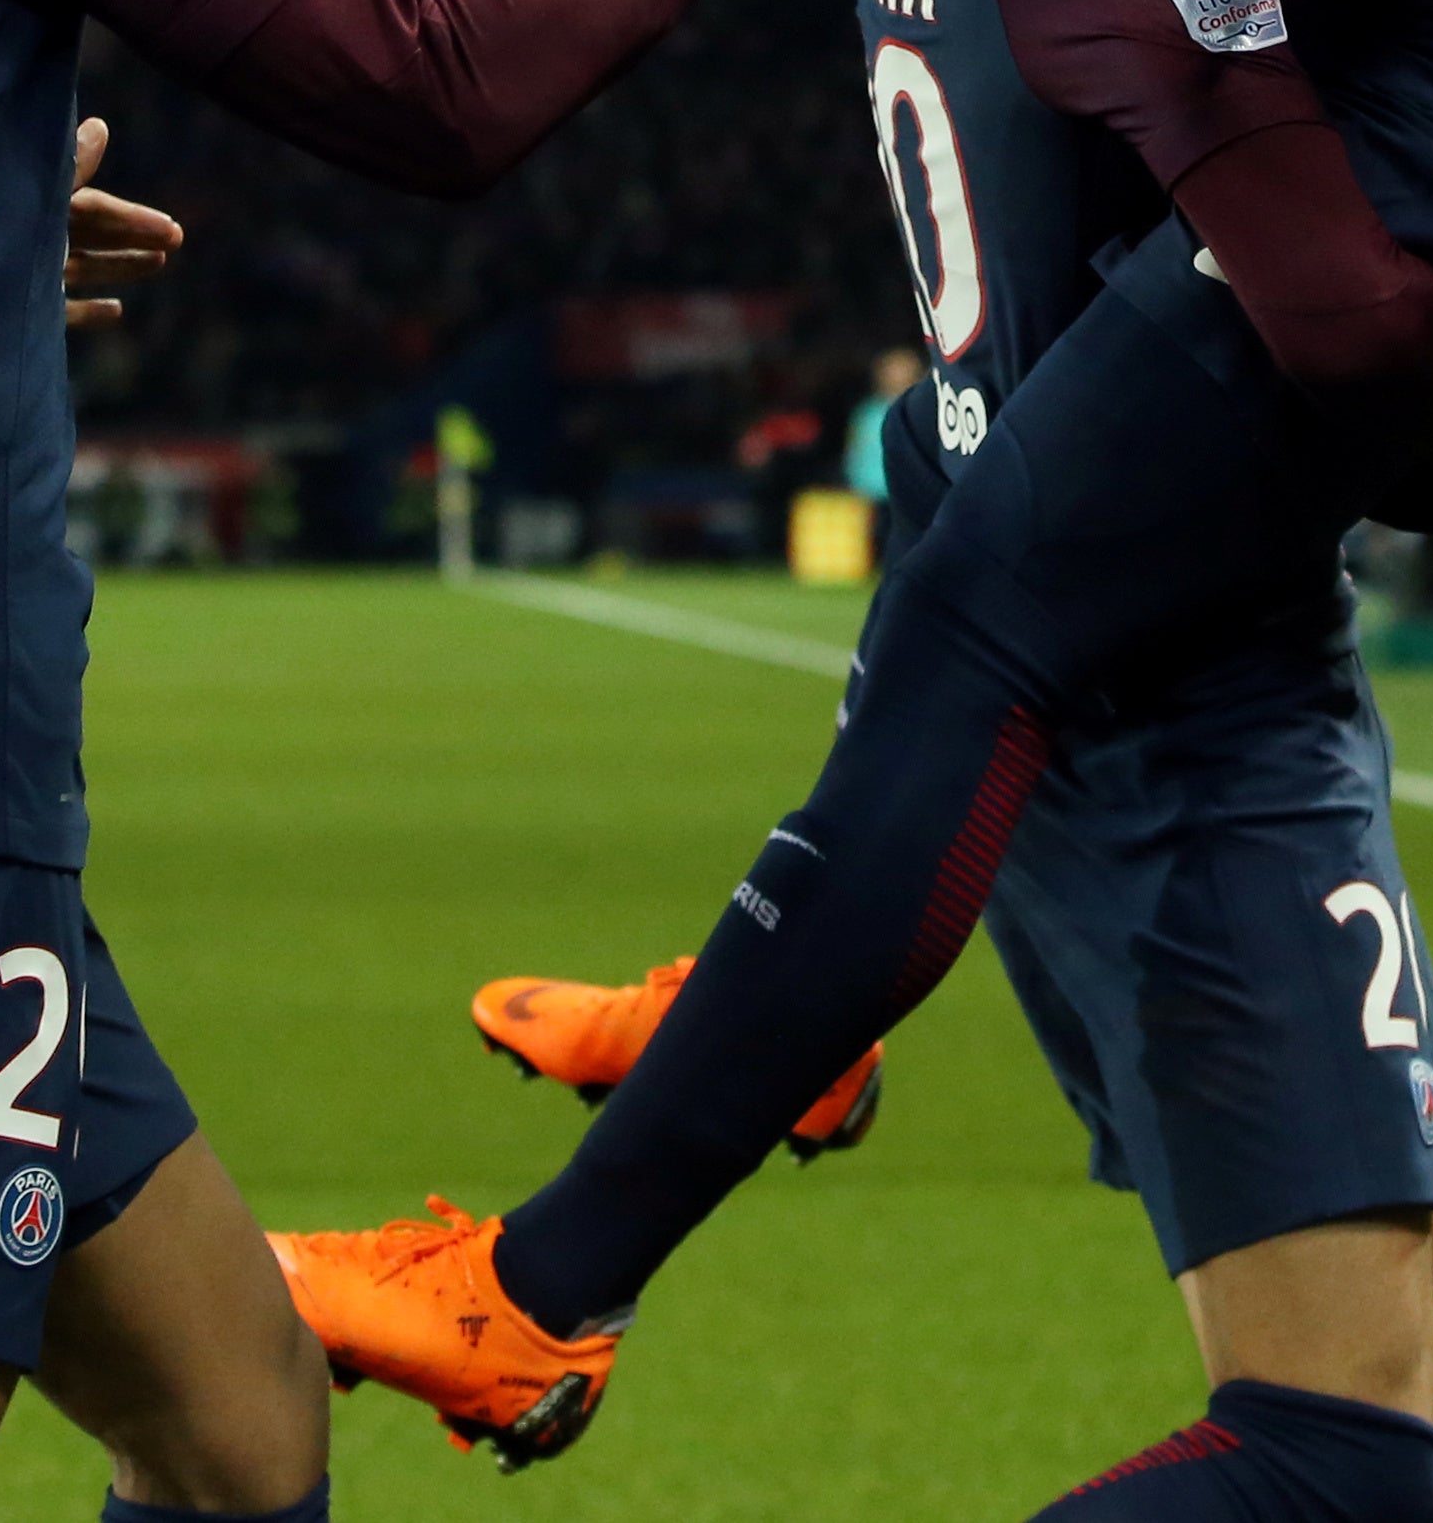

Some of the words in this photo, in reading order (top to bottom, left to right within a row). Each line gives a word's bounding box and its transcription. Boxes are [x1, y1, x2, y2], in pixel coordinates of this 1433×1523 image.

[868, 36, 987, 363] 0
[1322, 879, 1429, 1051] 2
[14, 1173, 59, 1201] PARIS
